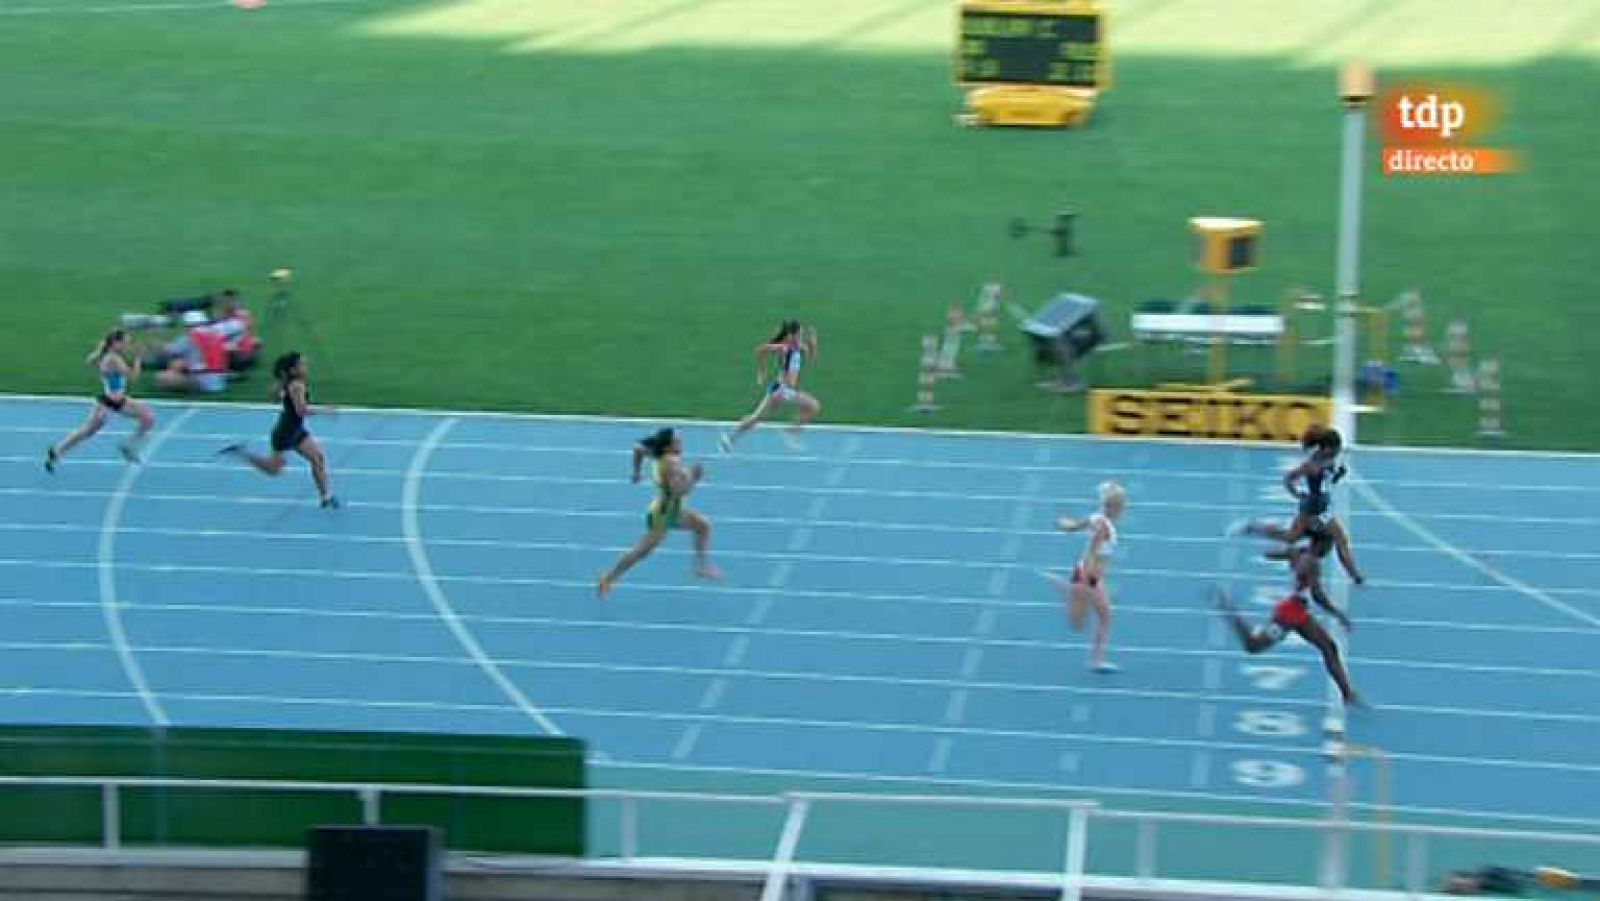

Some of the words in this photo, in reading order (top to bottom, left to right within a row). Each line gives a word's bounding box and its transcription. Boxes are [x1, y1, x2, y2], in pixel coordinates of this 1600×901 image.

[1108, 394, 1318, 441] SEIKO
[1234, 710, 1306, 736] 8
[1233, 759, 1305, 787] 9
